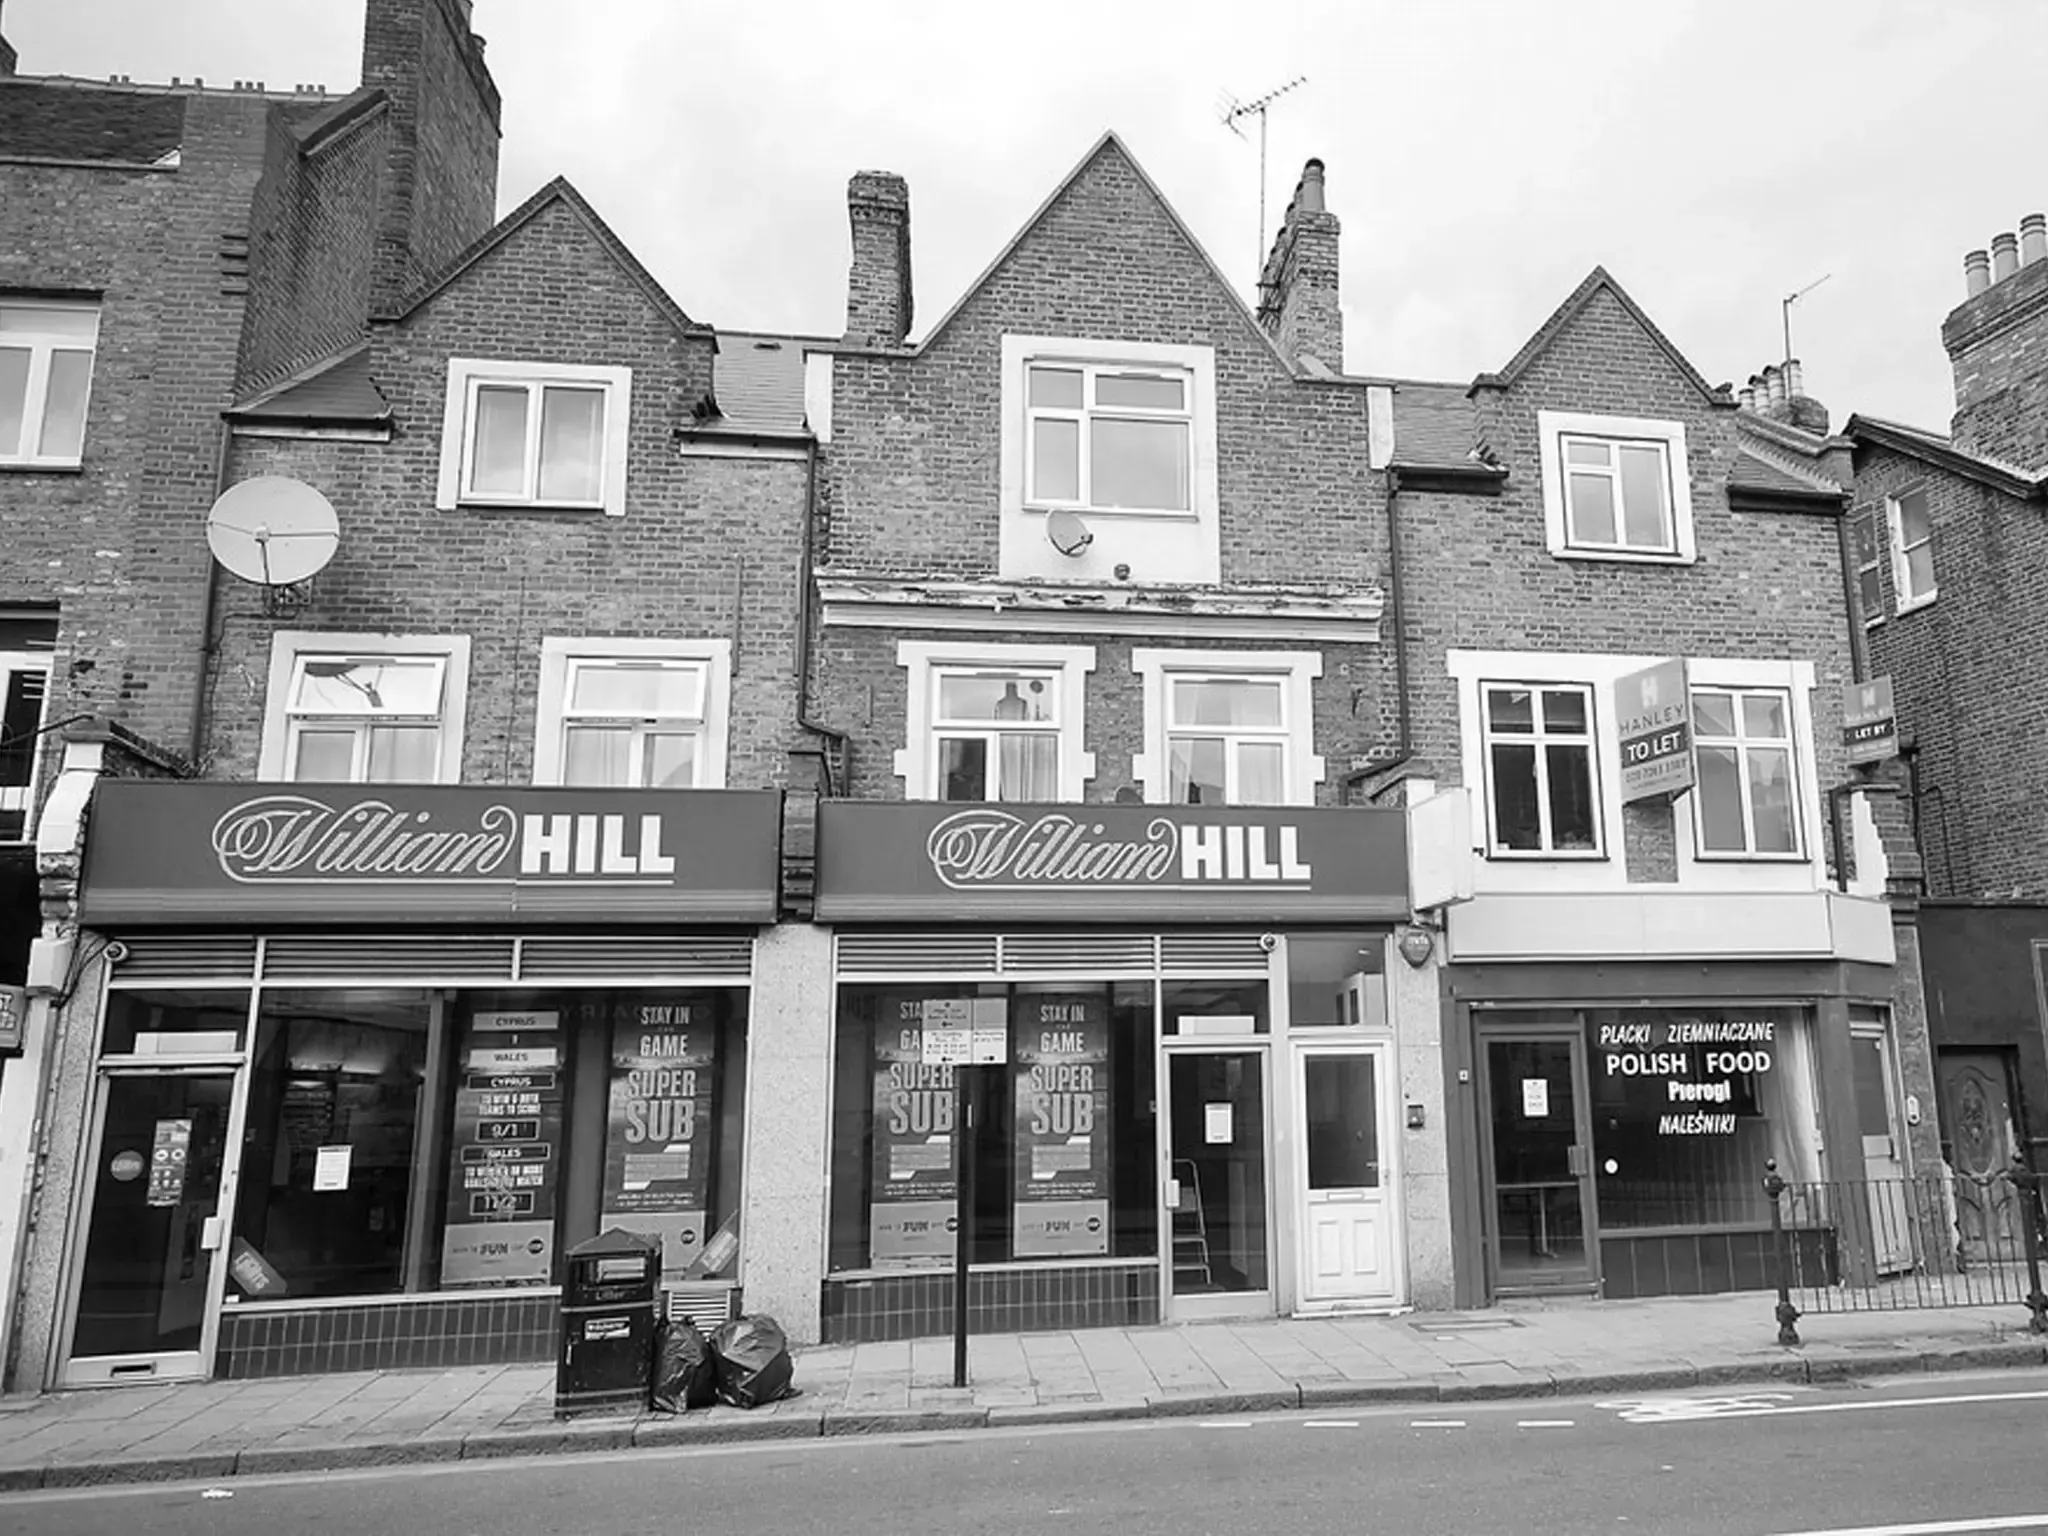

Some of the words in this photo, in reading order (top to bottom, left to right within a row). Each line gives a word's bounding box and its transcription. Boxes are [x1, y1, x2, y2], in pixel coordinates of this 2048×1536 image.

[1619, 702, 1684, 734] HANLEY
[1627, 742, 1649, 761] TO
[1653, 730, 1681, 756] LET
[1855, 727, 1871, 740] LET
[212, 795, 518, 884] William
[520, 814, 676, 874] HILL
[926, 809, 1179, 891] William
[1180, 825, 1312, 880] HILL
[495, 1015, 536, 1027] CYPRUS
[641, 1006, 673, 1025] STAY
[675, 1006, 690, 1025] IN
[901, 1001, 922, 1020] STA
[1040, 1004, 1070, 1022] STAY
[1071, 1004, 1085, 1022] IN
[640, 1034, 689, 1057] GAME
[901, 1029, 920, 1050] GA
[1040, 1031, 1085, 1053] GAME
[1600, 1024, 1651, 1045] PLACKI
[1667, 1021, 1775, 1044] ZIEMNIACZANE
[890, 1062, 954, 1089] SUPER
[1606, 1053, 1687, 1076] POLISH
[1706, 1051, 1771, 1074] FOOD
[491, 1076, 533, 1088] CYPRUS
[628, 1069, 697, 1098] SUPER
[1031, 1065, 1094, 1092] SUPER
[1667, 1079, 1732, 1103] Pierogi
[624, 1099, 695, 1143] SUB
[889, 1090, 953, 1134] SUB
[1031, 1092, 1094, 1134] SUB
[1658, 1109, 1736, 1135] NALEŚNIKI
